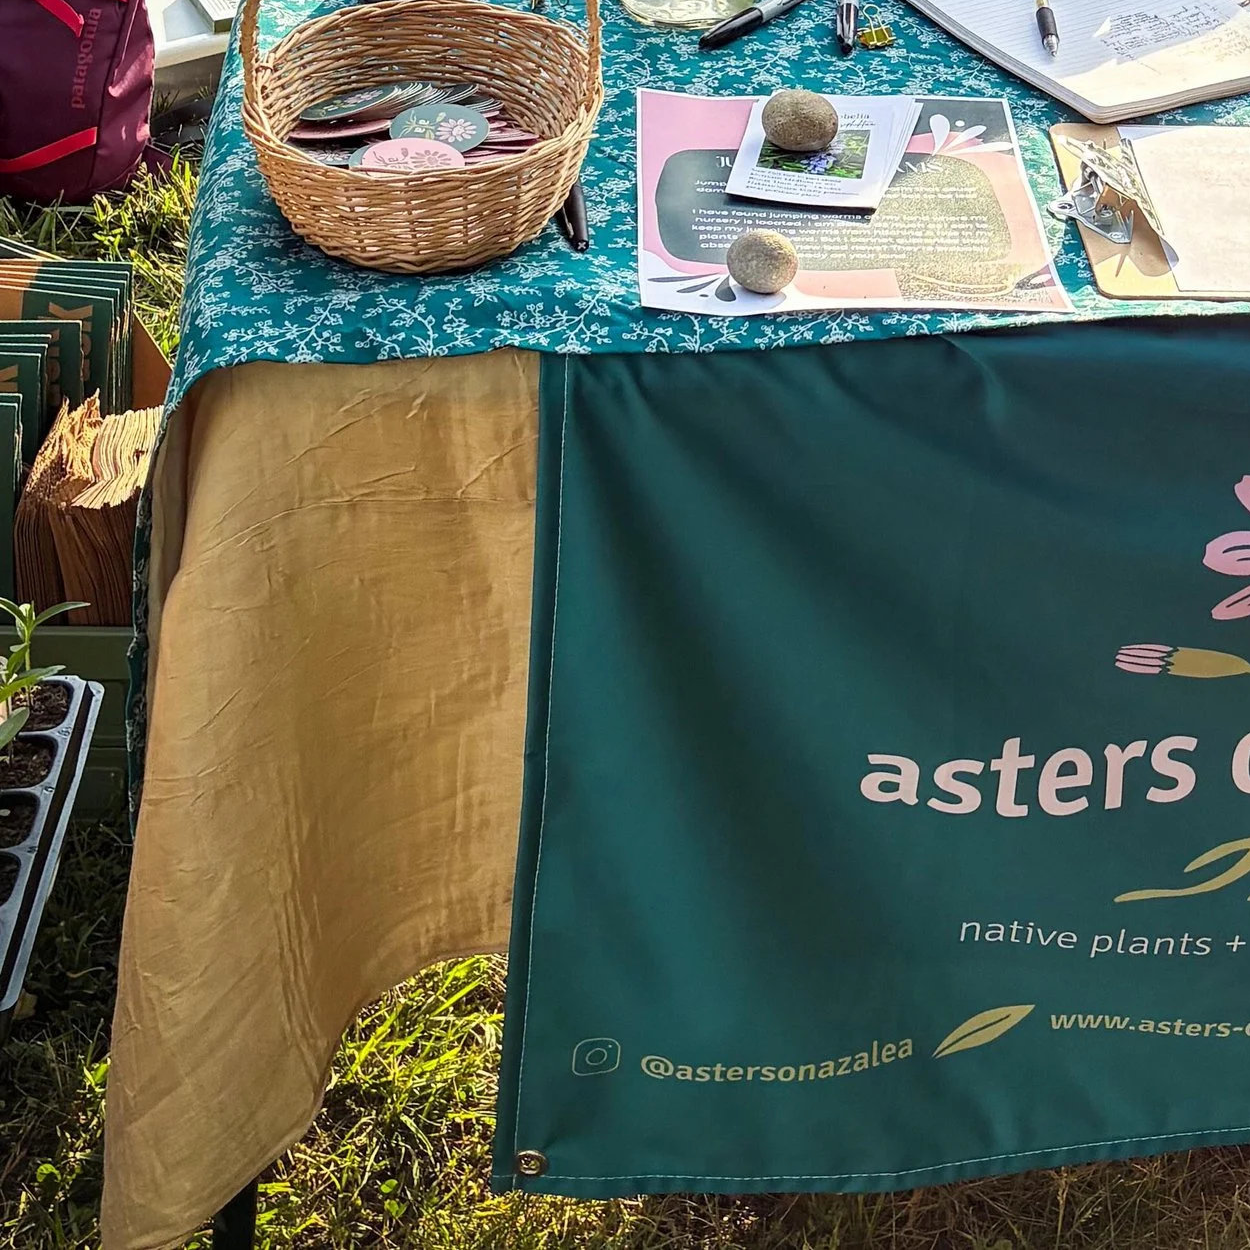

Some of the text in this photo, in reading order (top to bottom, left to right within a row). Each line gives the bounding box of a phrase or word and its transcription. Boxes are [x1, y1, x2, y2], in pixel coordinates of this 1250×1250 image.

[71, 7, 103, 109] patagonia
[695, 216, 740, 225] nursery
[732, 210, 766, 218] found
[769, 211, 819, 220] jumping
[691, 224, 722, 232] keep
[699, 234, 738, 242] plants
[859, 735, 1198, 818] asters
[959, 920, 1078, 949] native
[1090, 928, 1212, 958] plants
[1225, 935, 1247, 953] +
[640, 1038, 913, 1082] @astersonazalea
